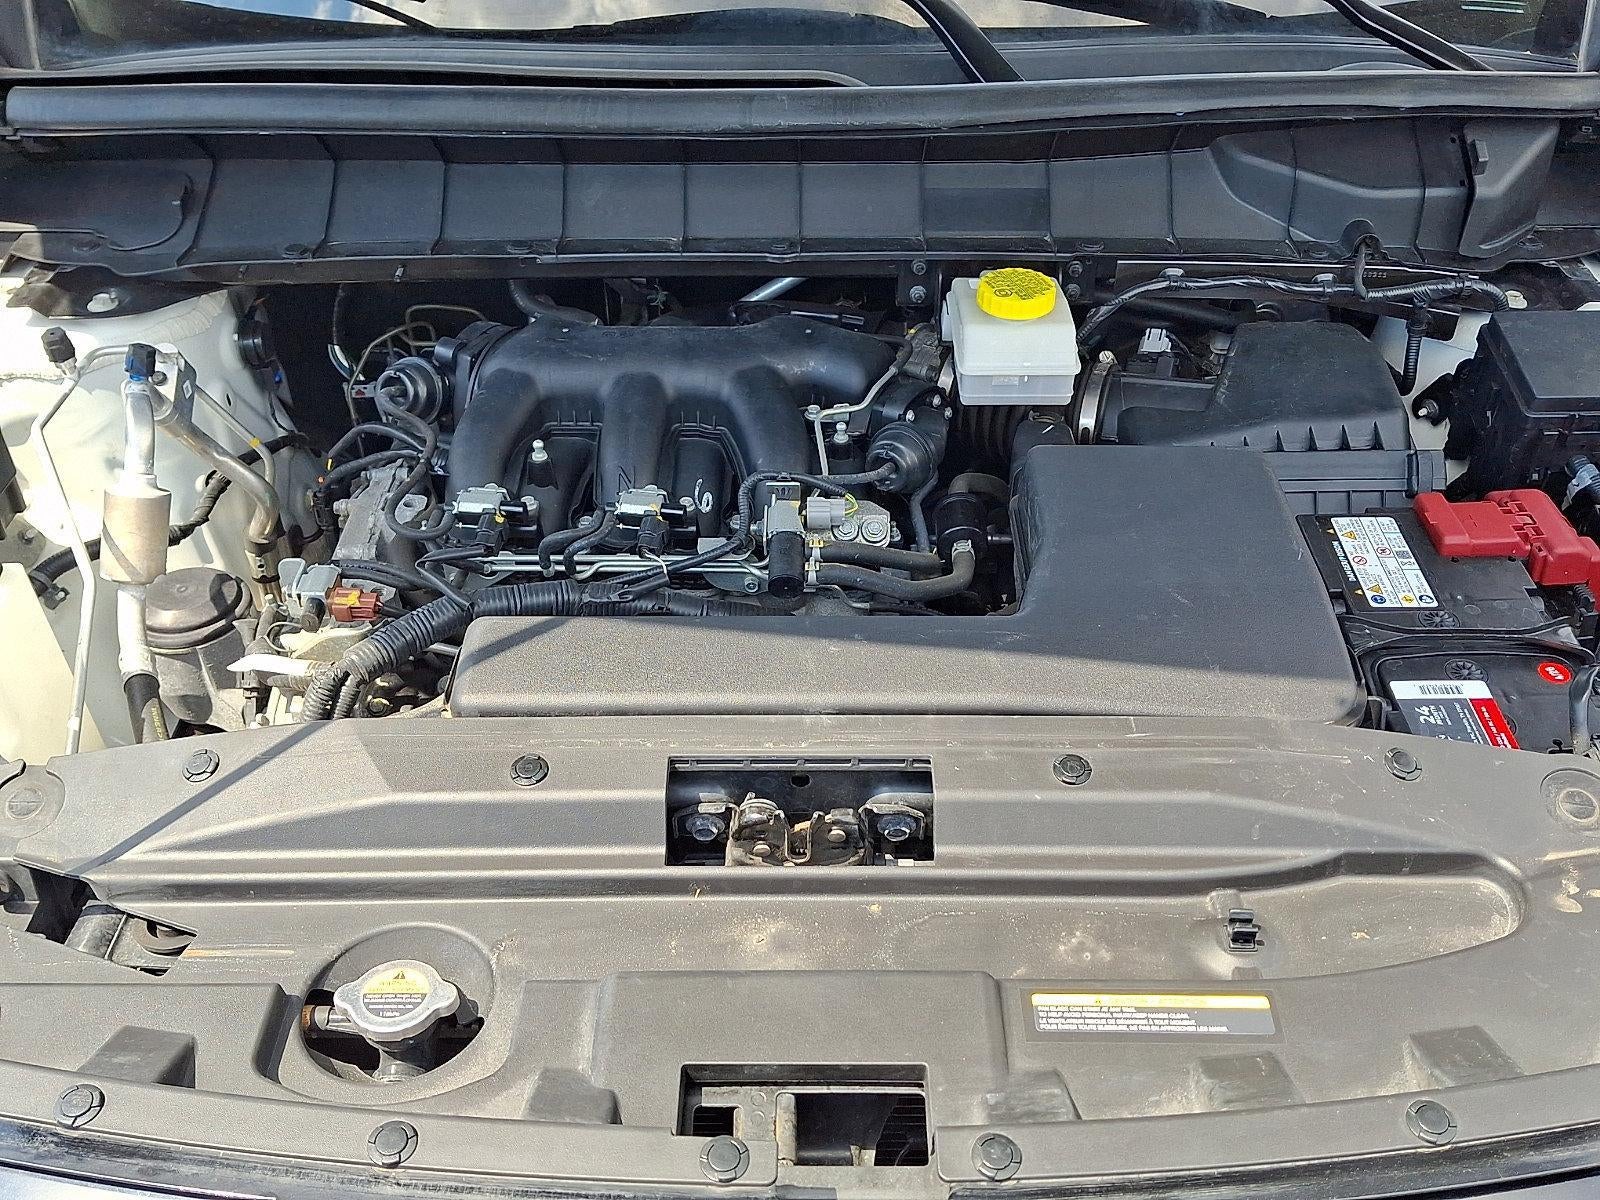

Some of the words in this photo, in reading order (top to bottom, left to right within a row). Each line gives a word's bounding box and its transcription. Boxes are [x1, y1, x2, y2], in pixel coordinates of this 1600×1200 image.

[695, 479, 713, 513] 6
[1414, 705, 1436, 724] 24
[1428, 705, 1443, 725] MONTH
